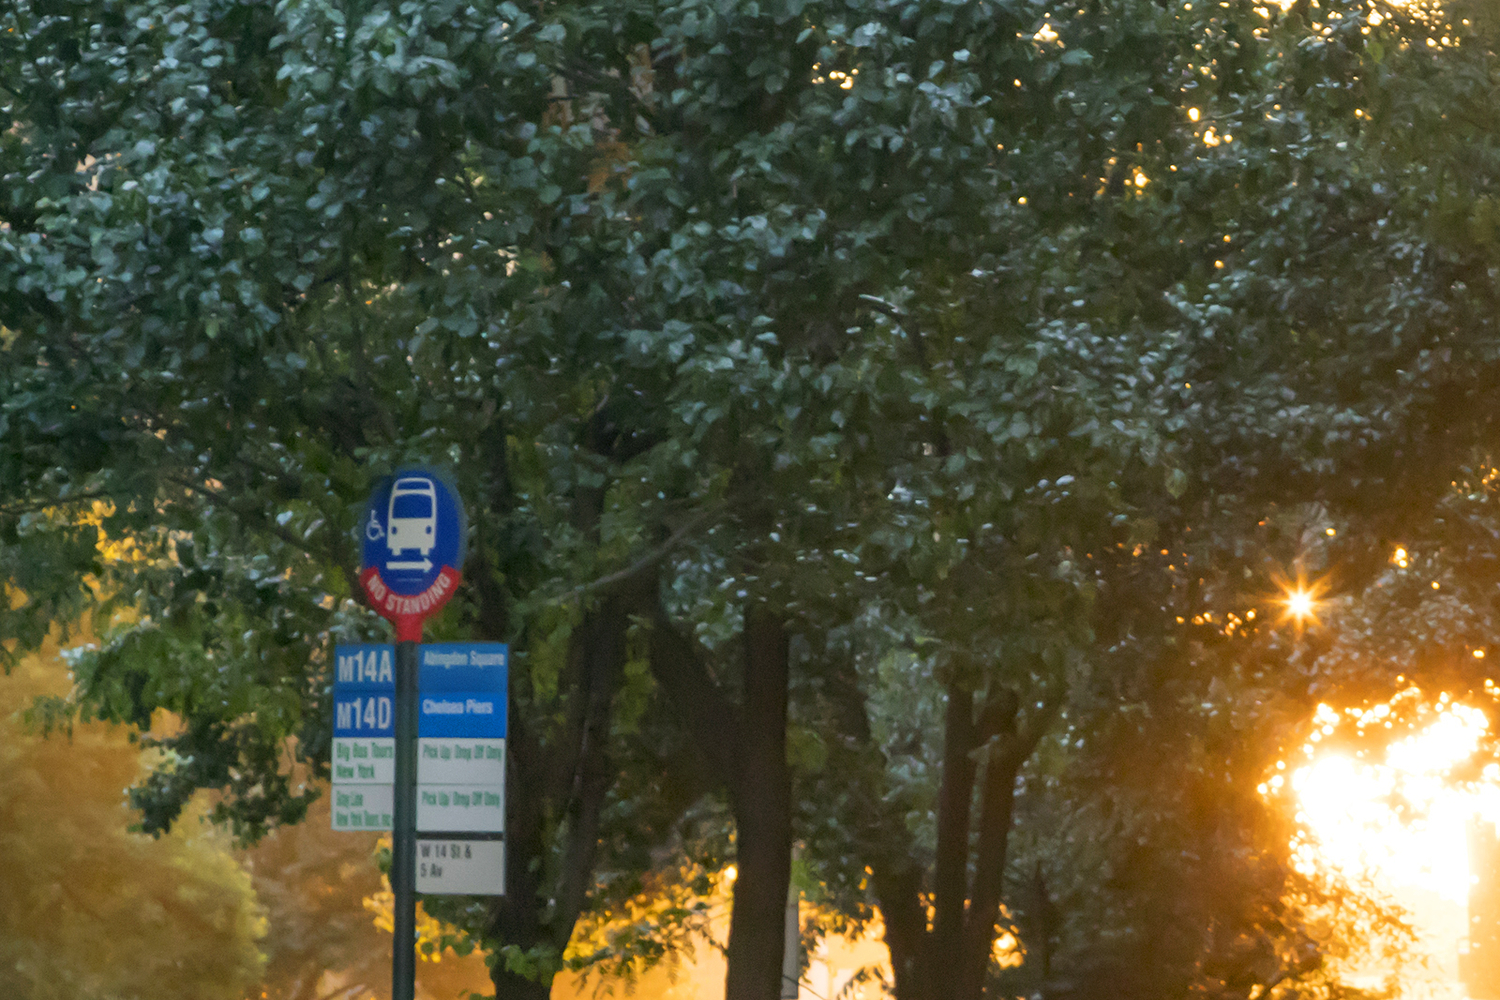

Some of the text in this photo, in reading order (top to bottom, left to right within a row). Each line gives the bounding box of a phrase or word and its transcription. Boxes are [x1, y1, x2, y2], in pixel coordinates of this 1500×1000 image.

[367, 573, 451, 615] NO STANDING
[338, 650, 393, 682] M14A
[470, 650, 505, 669] Square
[337, 697, 391, 729] M14D
[420, 844, 431, 858] W
[435, 844, 447, 858] 14
